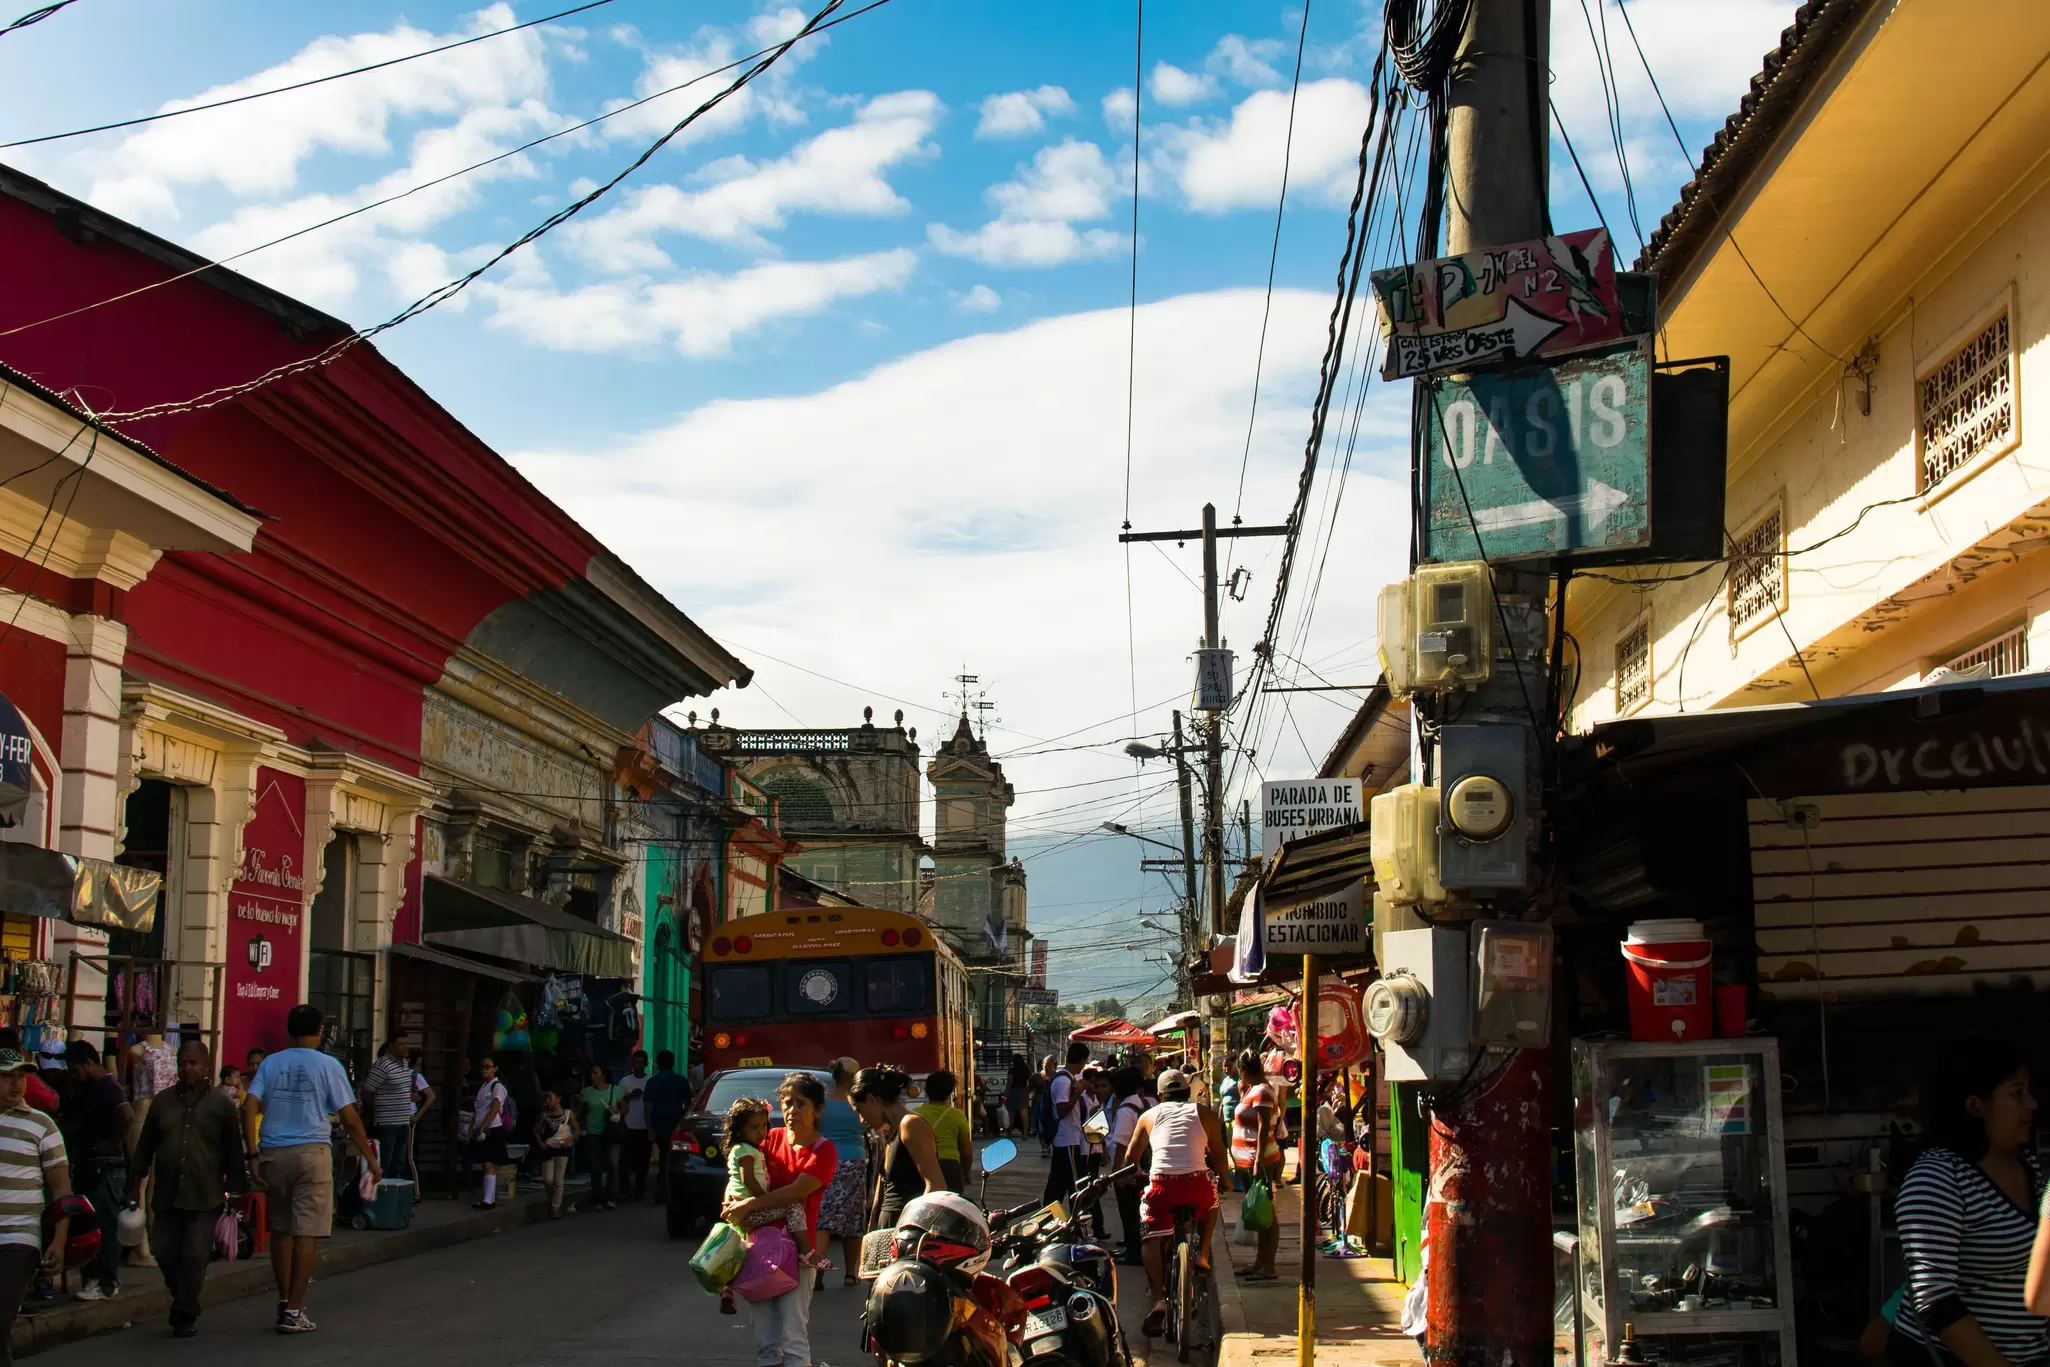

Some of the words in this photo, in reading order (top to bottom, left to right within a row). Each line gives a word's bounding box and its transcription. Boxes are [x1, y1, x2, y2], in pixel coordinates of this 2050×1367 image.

[1404, 347, 1430, 372] 25
[1465, 327, 1515, 355] OESTE
[1442, 374, 1628, 470] OASIS
[1839, 742, 1906, 788] Dr
[1271, 785, 1327, 806] PARADA
[1334, 785, 1352, 804] DE
[1265, 808, 1305, 828] BUSES
[1308, 806, 1360, 826] URBANA
[1277, 902, 1348, 921] ROHIBIDO
[1267, 924, 1359, 943] ESTACIONAR
[744, 1059, 766, 1067] TAXI
